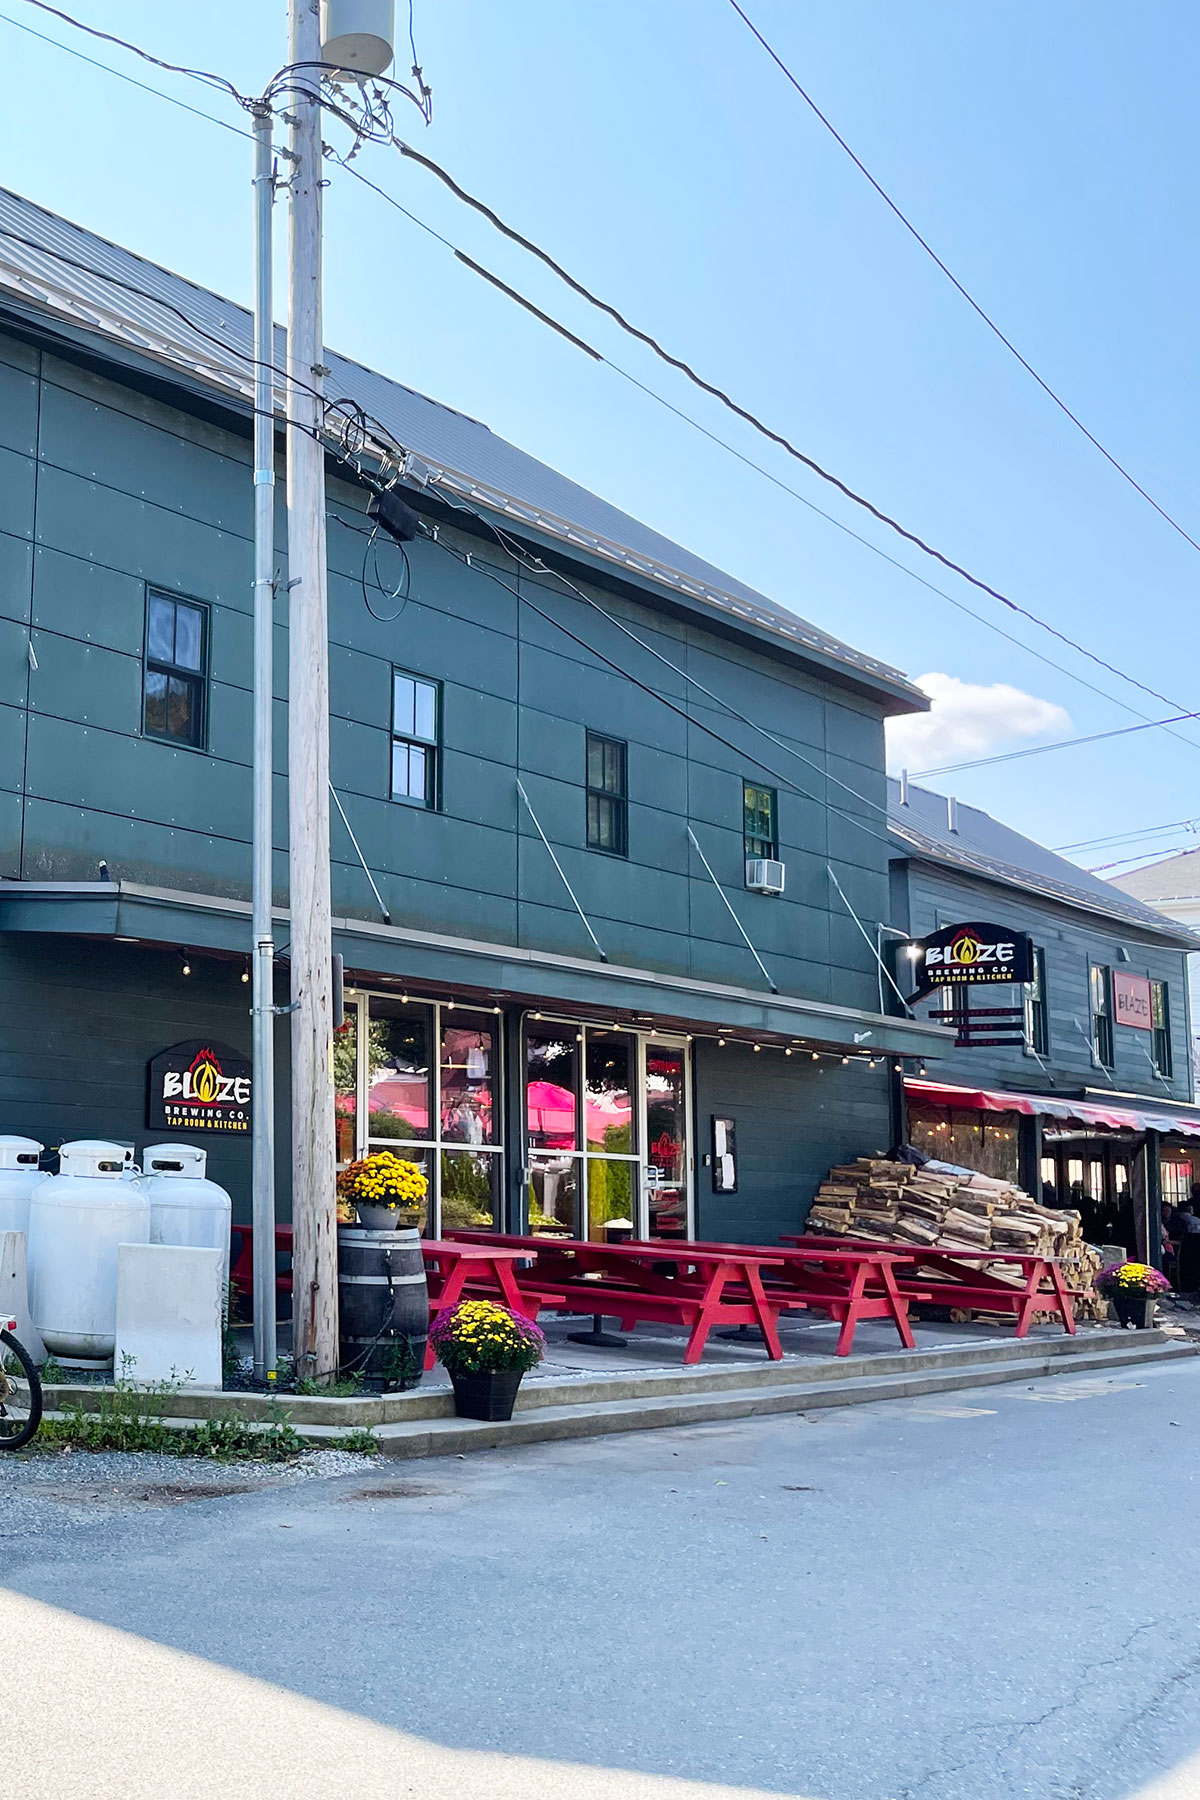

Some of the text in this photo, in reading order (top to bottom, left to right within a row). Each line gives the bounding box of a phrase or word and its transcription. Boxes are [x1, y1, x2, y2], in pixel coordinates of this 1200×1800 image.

[928, 967, 984, 976] BREWING
[976, 973, 1012, 981] KITCHEN
[1118, 993, 1148, 1016] BLAZE
[165, 1106, 249, 1120] BREWING CO.
[167, 1117, 247, 1130] TAP ROOM & KITCHEN
